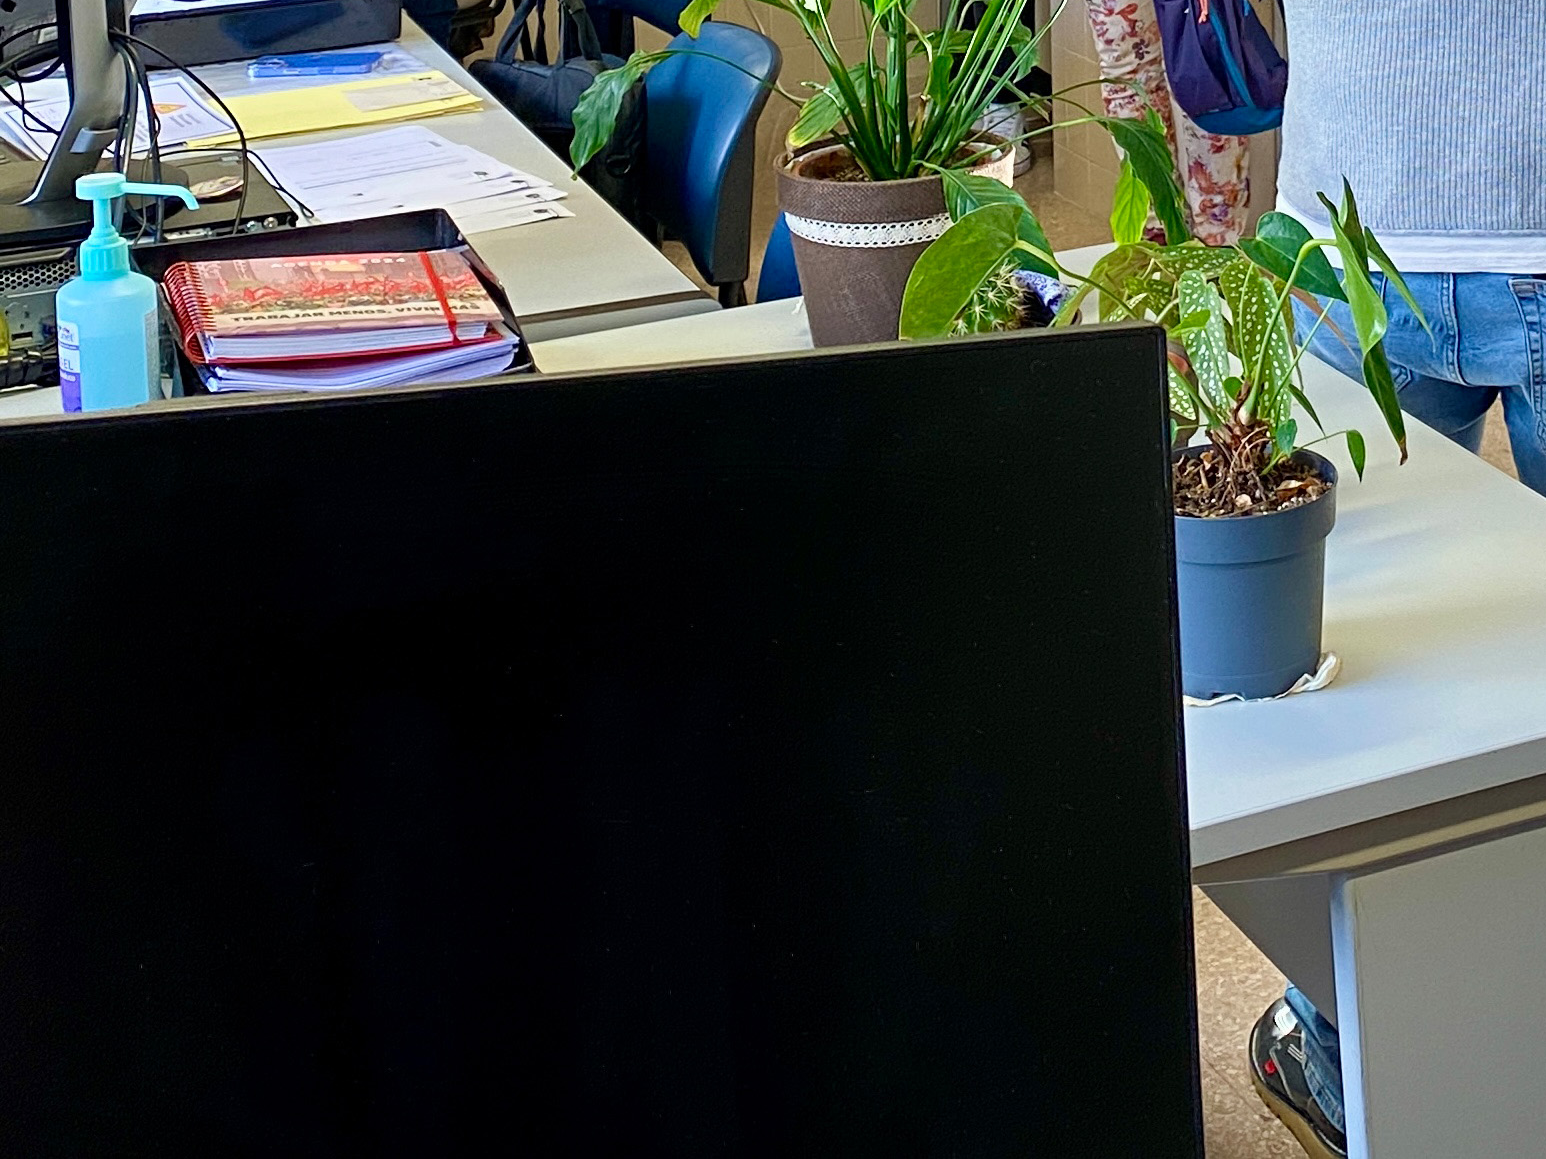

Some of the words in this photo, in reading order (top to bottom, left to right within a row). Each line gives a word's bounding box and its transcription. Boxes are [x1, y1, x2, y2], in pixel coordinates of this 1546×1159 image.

[271, 260, 349, 268] AGENDA
[358, 257, 406, 265] 2024
[232, 312, 324, 322] TRABAJAR
[395, 305, 441, 313] VIVIR
